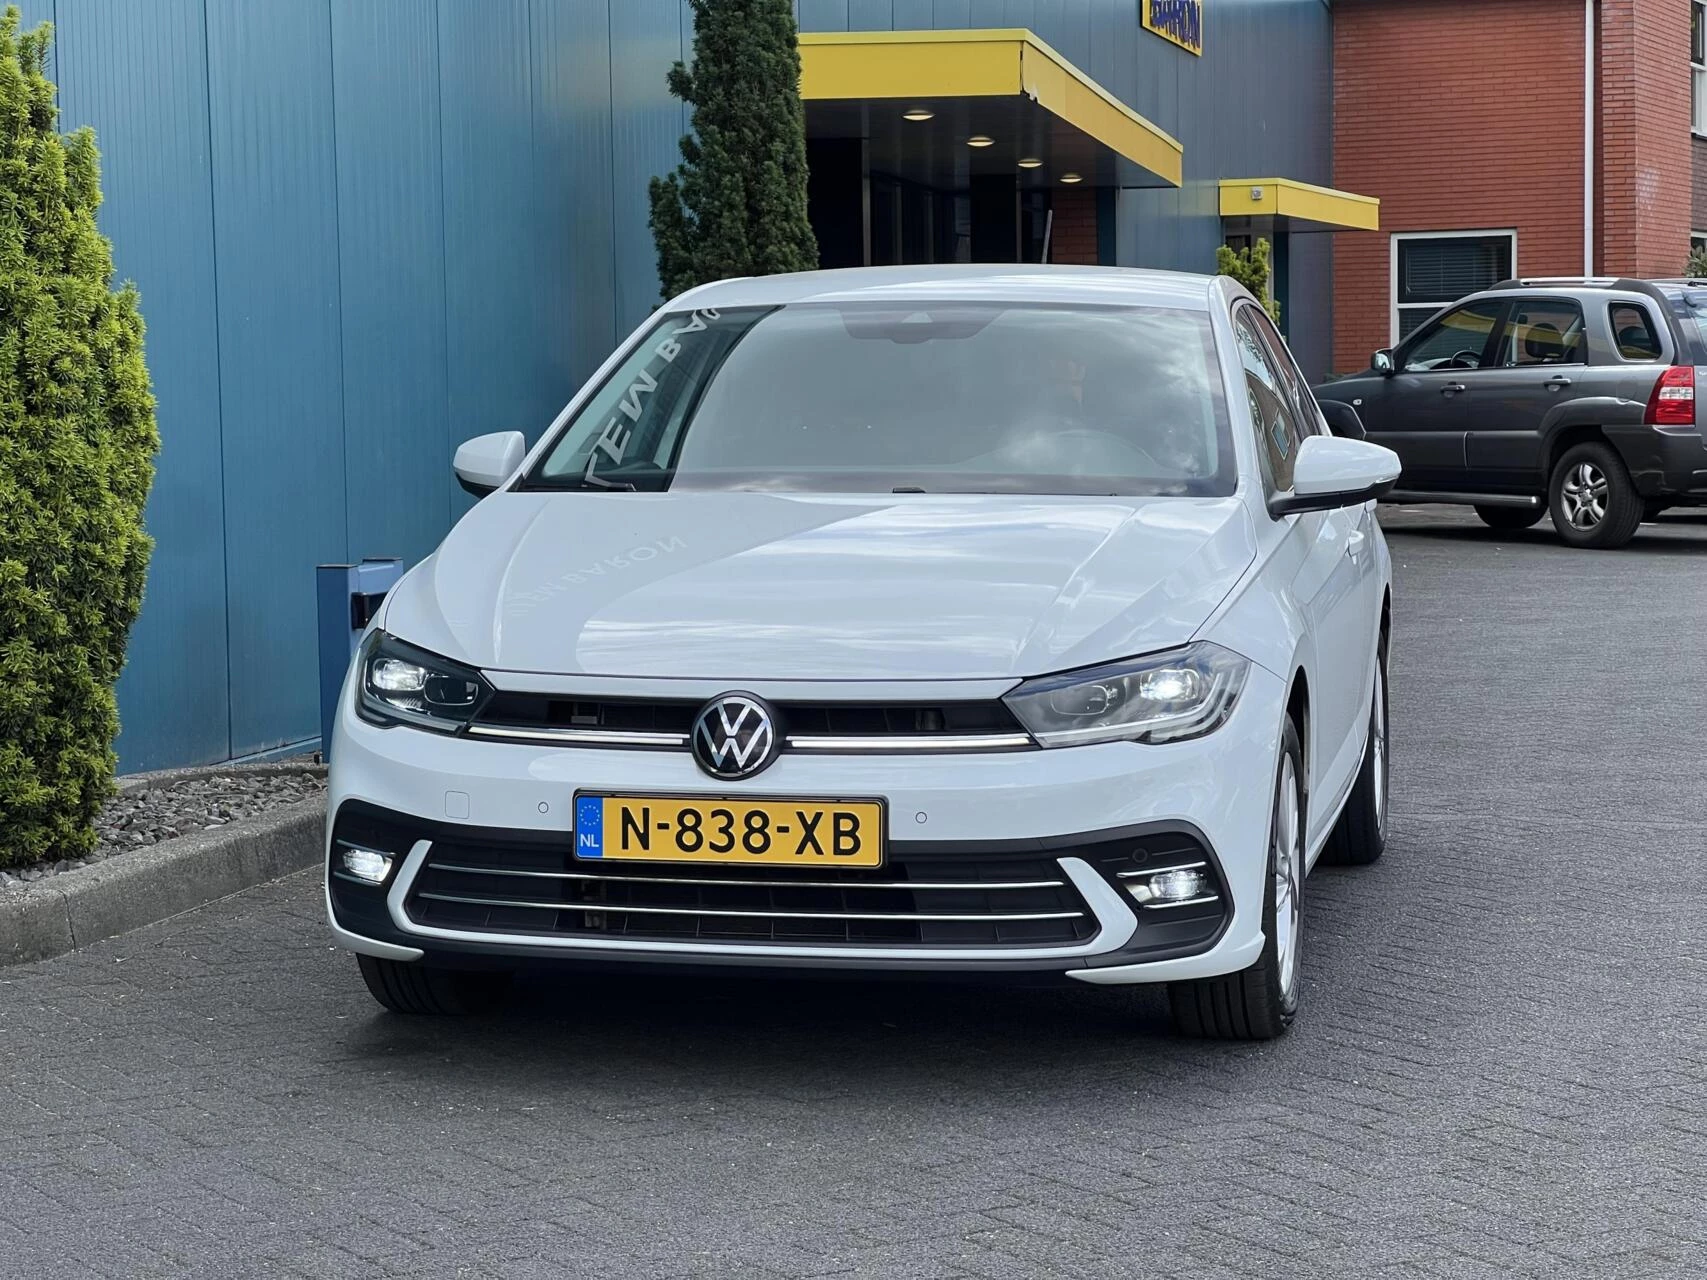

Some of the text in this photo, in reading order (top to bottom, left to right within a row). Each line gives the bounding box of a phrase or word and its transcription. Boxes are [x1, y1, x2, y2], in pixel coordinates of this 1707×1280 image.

[696, 698, 771, 772] VW
[580, 834, 600, 848] NL
[620, 806, 861, 856] N-838-XB
